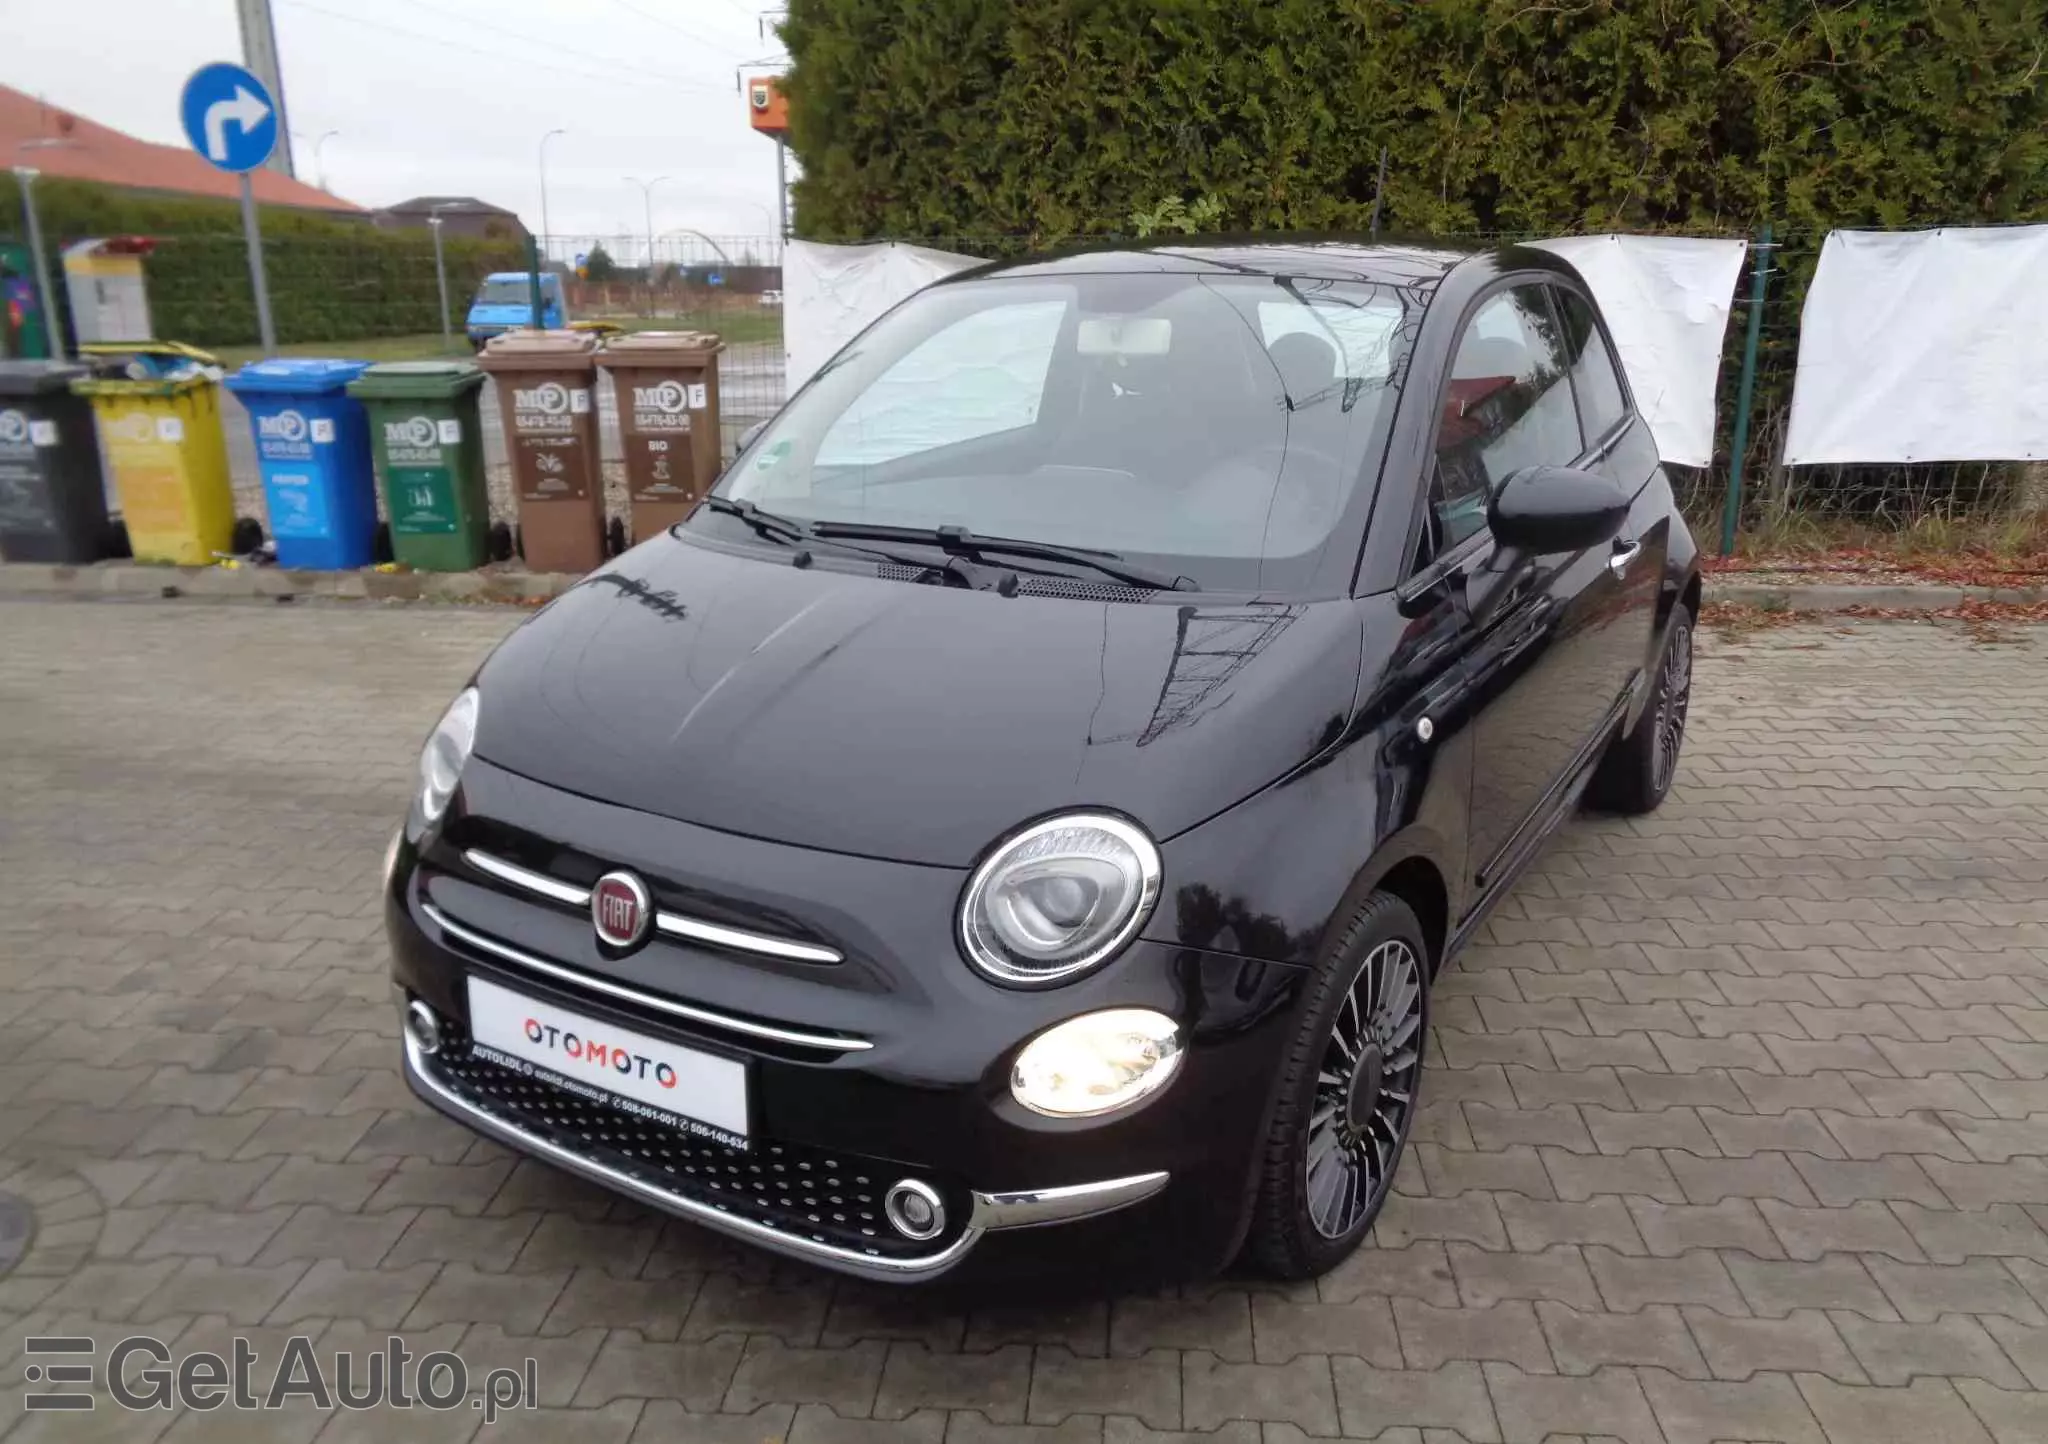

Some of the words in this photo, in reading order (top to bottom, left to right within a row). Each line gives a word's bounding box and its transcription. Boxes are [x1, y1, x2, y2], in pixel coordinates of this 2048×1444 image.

[647, 440, 668, 452] BIO
[602, 893, 634, 931] FIAT
[525, 1018, 677, 1089] OTOMOTO
